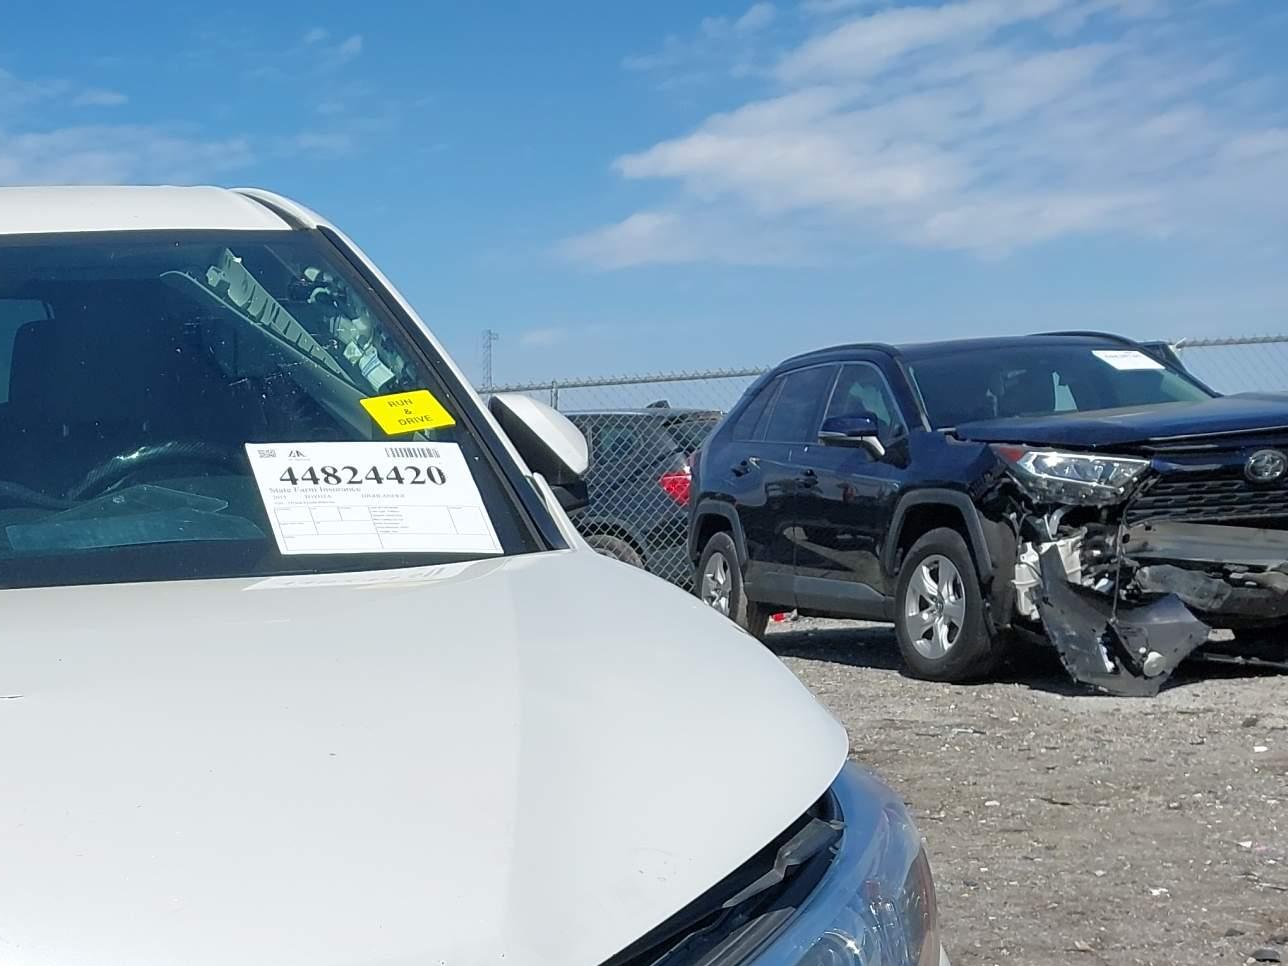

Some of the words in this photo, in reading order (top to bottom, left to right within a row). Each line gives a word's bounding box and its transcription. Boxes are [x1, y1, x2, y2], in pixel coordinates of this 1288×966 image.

[387, 398, 413, 408] RUN
[398, 414, 433, 426] DRIVE
[279, 465, 447, 486] 44824420
